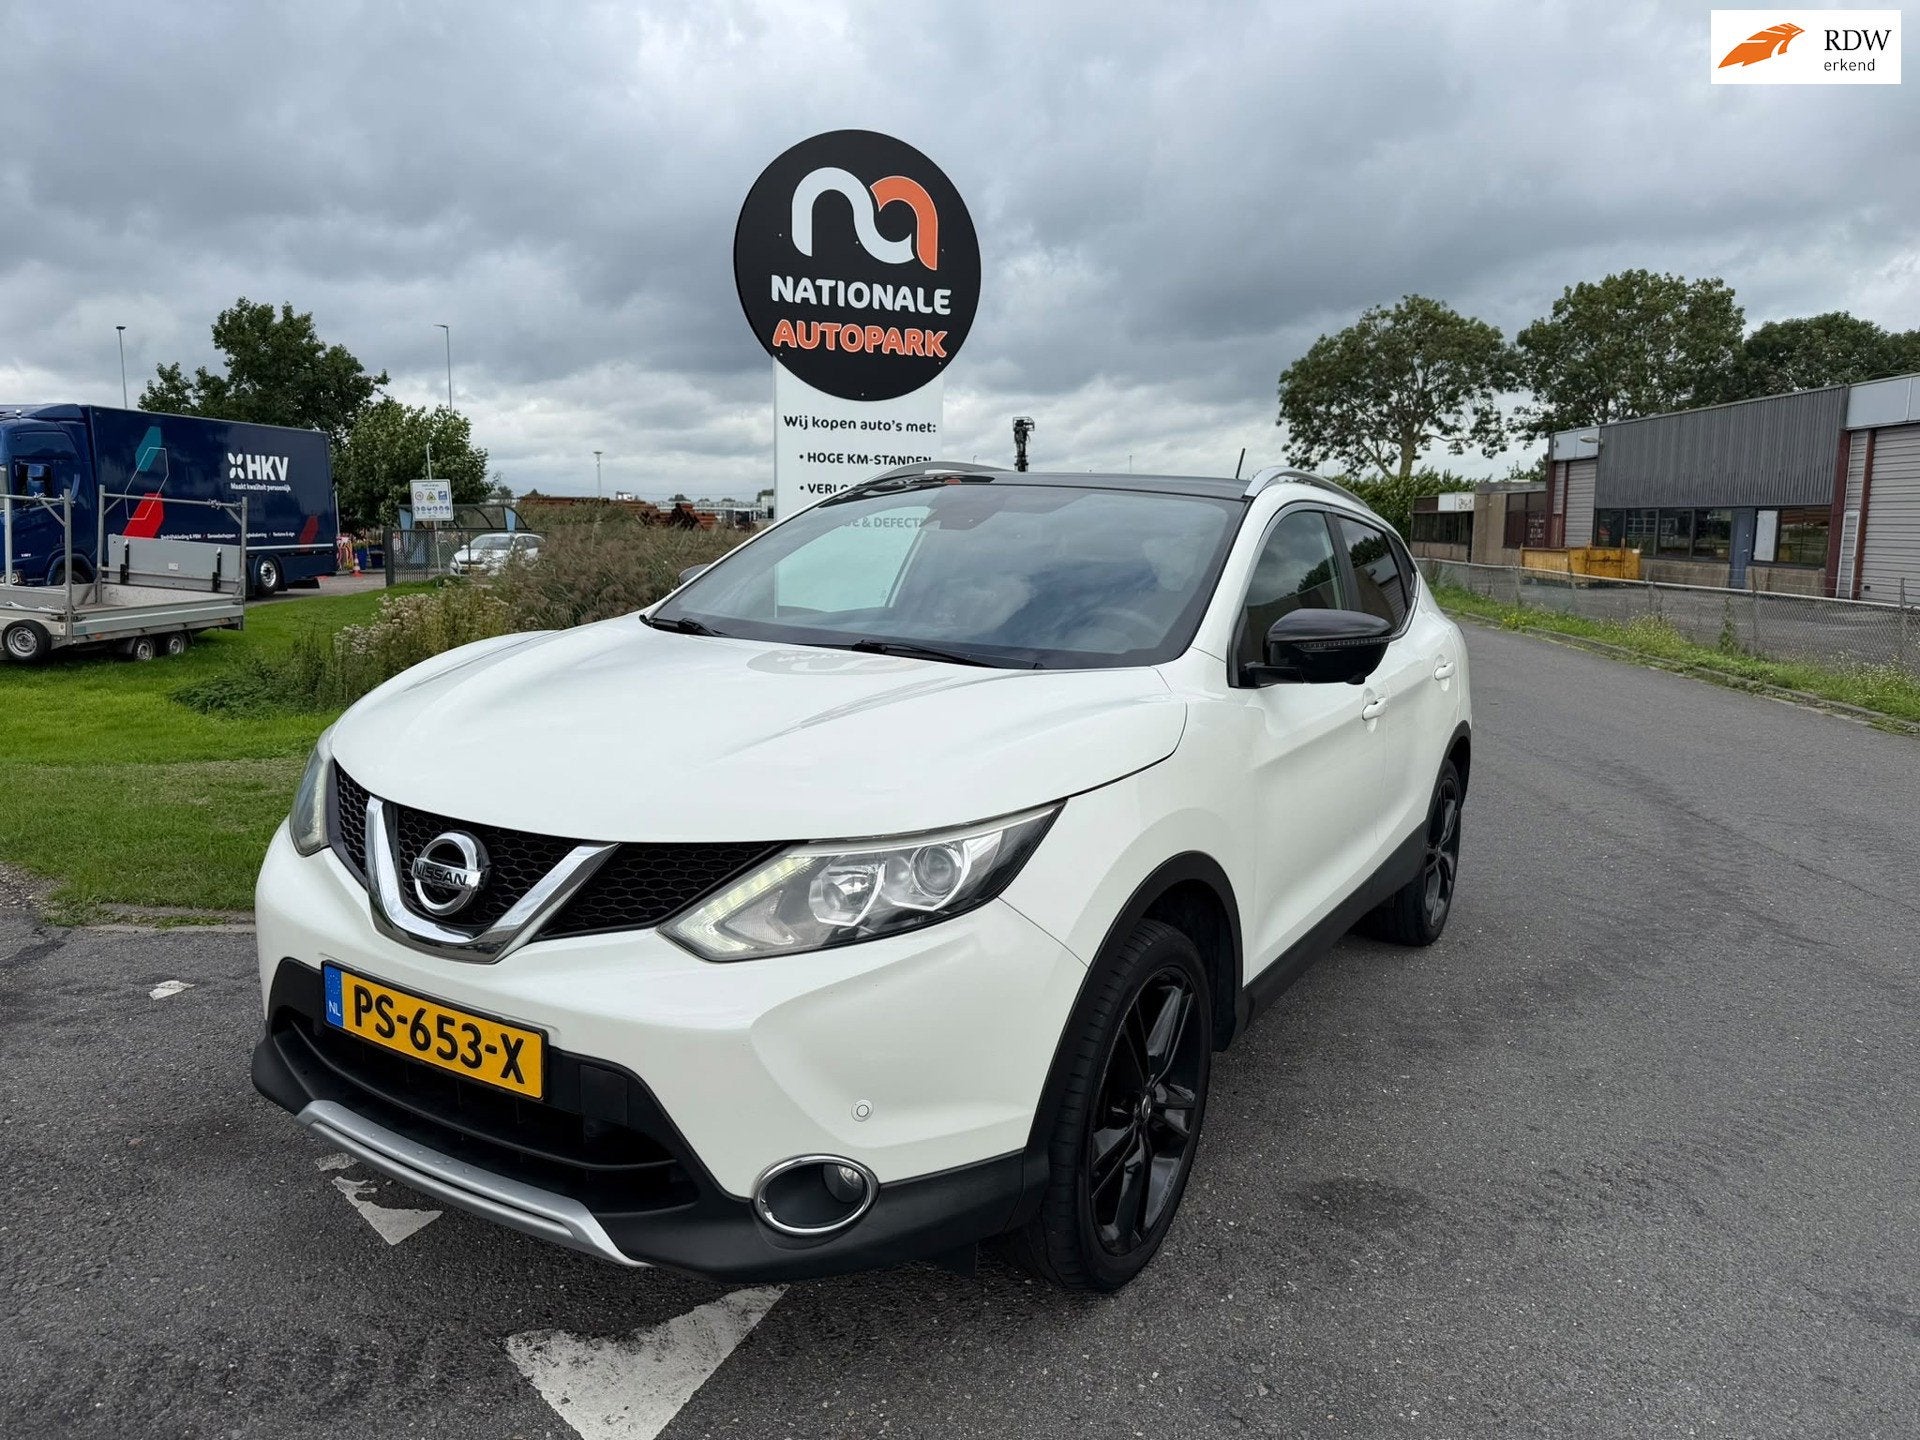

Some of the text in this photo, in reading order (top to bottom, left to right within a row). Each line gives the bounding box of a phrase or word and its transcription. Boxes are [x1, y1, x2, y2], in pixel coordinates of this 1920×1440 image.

[771, 274, 951, 315] NATIONALE
[772, 319, 948, 358] AUTOPARK
[783, 415, 937, 433] Wij kopen auto's met:
[246, 454, 289, 481] HKV
[807, 452, 844, 464] HOGE
[230, 482, 291, 493] Maakt kwaliteit persoonlijk
[414, 861, 467, 886] NISSAN
[328, 1001, 341, 1017] NL
[353, 984, 525, 1085] PS-653-X
